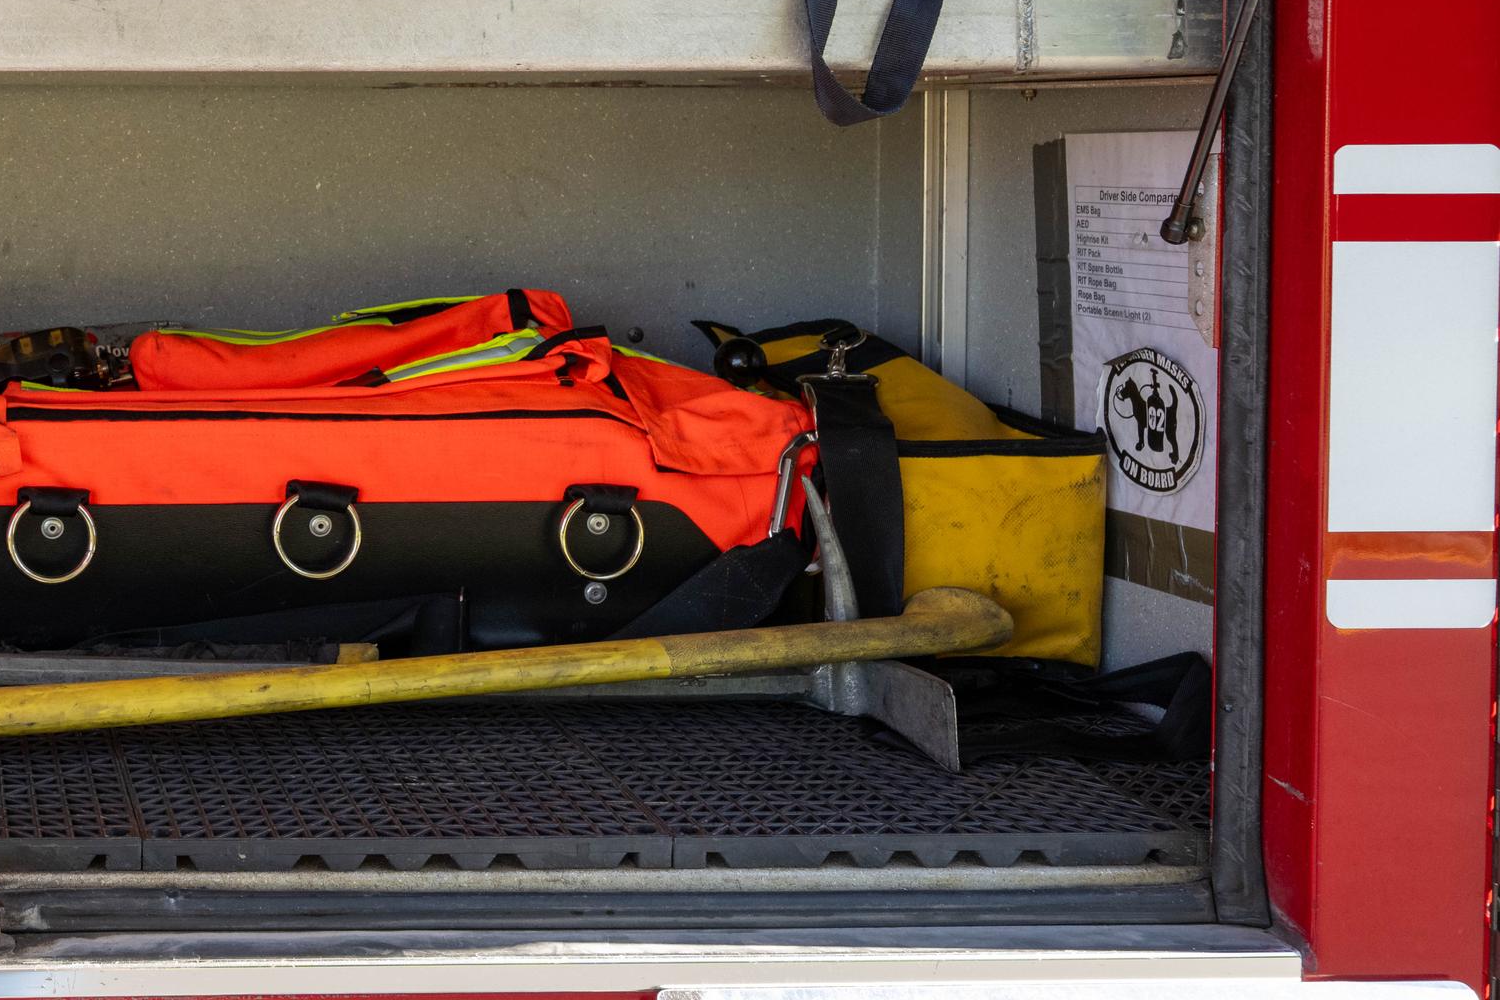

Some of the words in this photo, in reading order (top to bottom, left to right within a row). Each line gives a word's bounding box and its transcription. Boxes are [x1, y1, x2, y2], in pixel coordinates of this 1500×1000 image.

[1100, 190, 1119, 201] Driver
[1120, 191, 1137, 202] Side
[1139, 191, 1180, 205] Compart
[1076, 205, 1089, 214] EMS
[1091, 206, 1101, 216] Bag
[1076, 220, 1090, 228] AED
[1077, 234, 1100, 245] Highrise
[1101, 235, 1109, 244] Kit
[1077, 248, 1087, 256] RIT
[1088, 249, 1101, 258] Pack
[1077, 262, 1086, 271] RIT
[1088, 263, 1104, 273] Spare
[1105, 264, 1123, 274] Bottle
[1077, 276, 1087, 285] RIT
[1088, 277, 1103, 287] Rope
[1104, 279, 1117, 290] Bag
[1078, 290, 1092, 301] Rope
[1093, 292, 1106, 304] Bag
[1077, 304, 1102, 316] Portable
[1124, 309, 1141, 320] Light
[1142, 312, 1151, 321] (2)
[1156, 353, 1189, 389] MASKS
[1123, 455, 1139, 478] ON
[1140, 468, 1175, 488] BOARD
